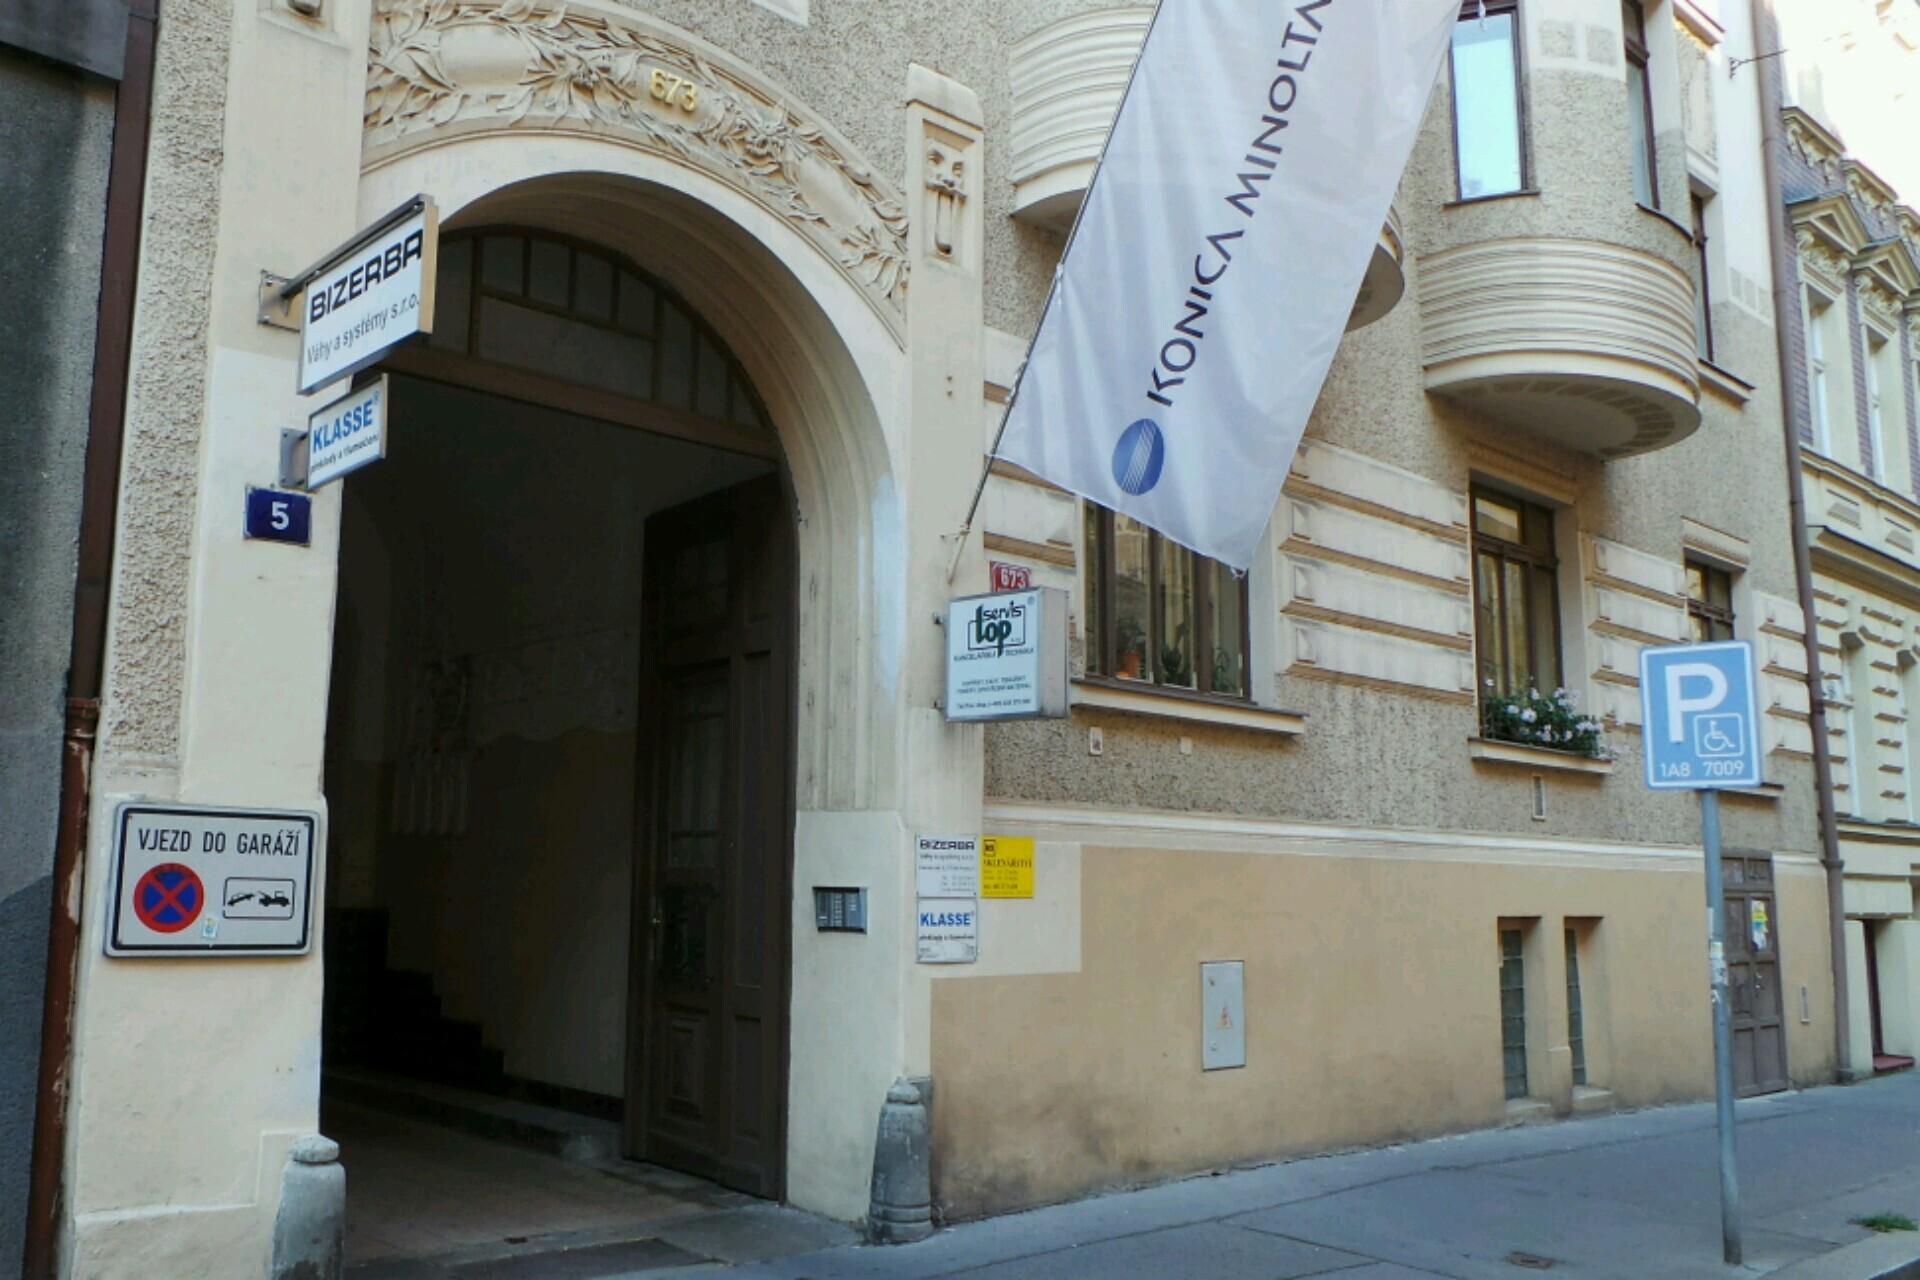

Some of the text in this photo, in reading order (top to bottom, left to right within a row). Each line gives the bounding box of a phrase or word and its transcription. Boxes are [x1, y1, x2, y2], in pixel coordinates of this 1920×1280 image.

[651, 68, 698, 112] 673
[1147, 0, 1333, 407] KONICA MINOLTA
[310, 229, 424, 325] BIZERBA
[333, 334, 341, 351] a
[342, 308, 389, 349] systémy
[313, 400, 373, 454] KLASSE
[271, 501, 290, 531] 5
[1001, 568, 1027, 590] 673
[975, 602, 1013, 658] top
[983, 600, 1022, 621] servis
[1665, 663, 1728, 743] P
[1703, 760, 1745, 776] 7009
[138, 828, 301, 856] VJEZD DO GARÁŽÍ
[920, 912, 971, 927] KLASSE
